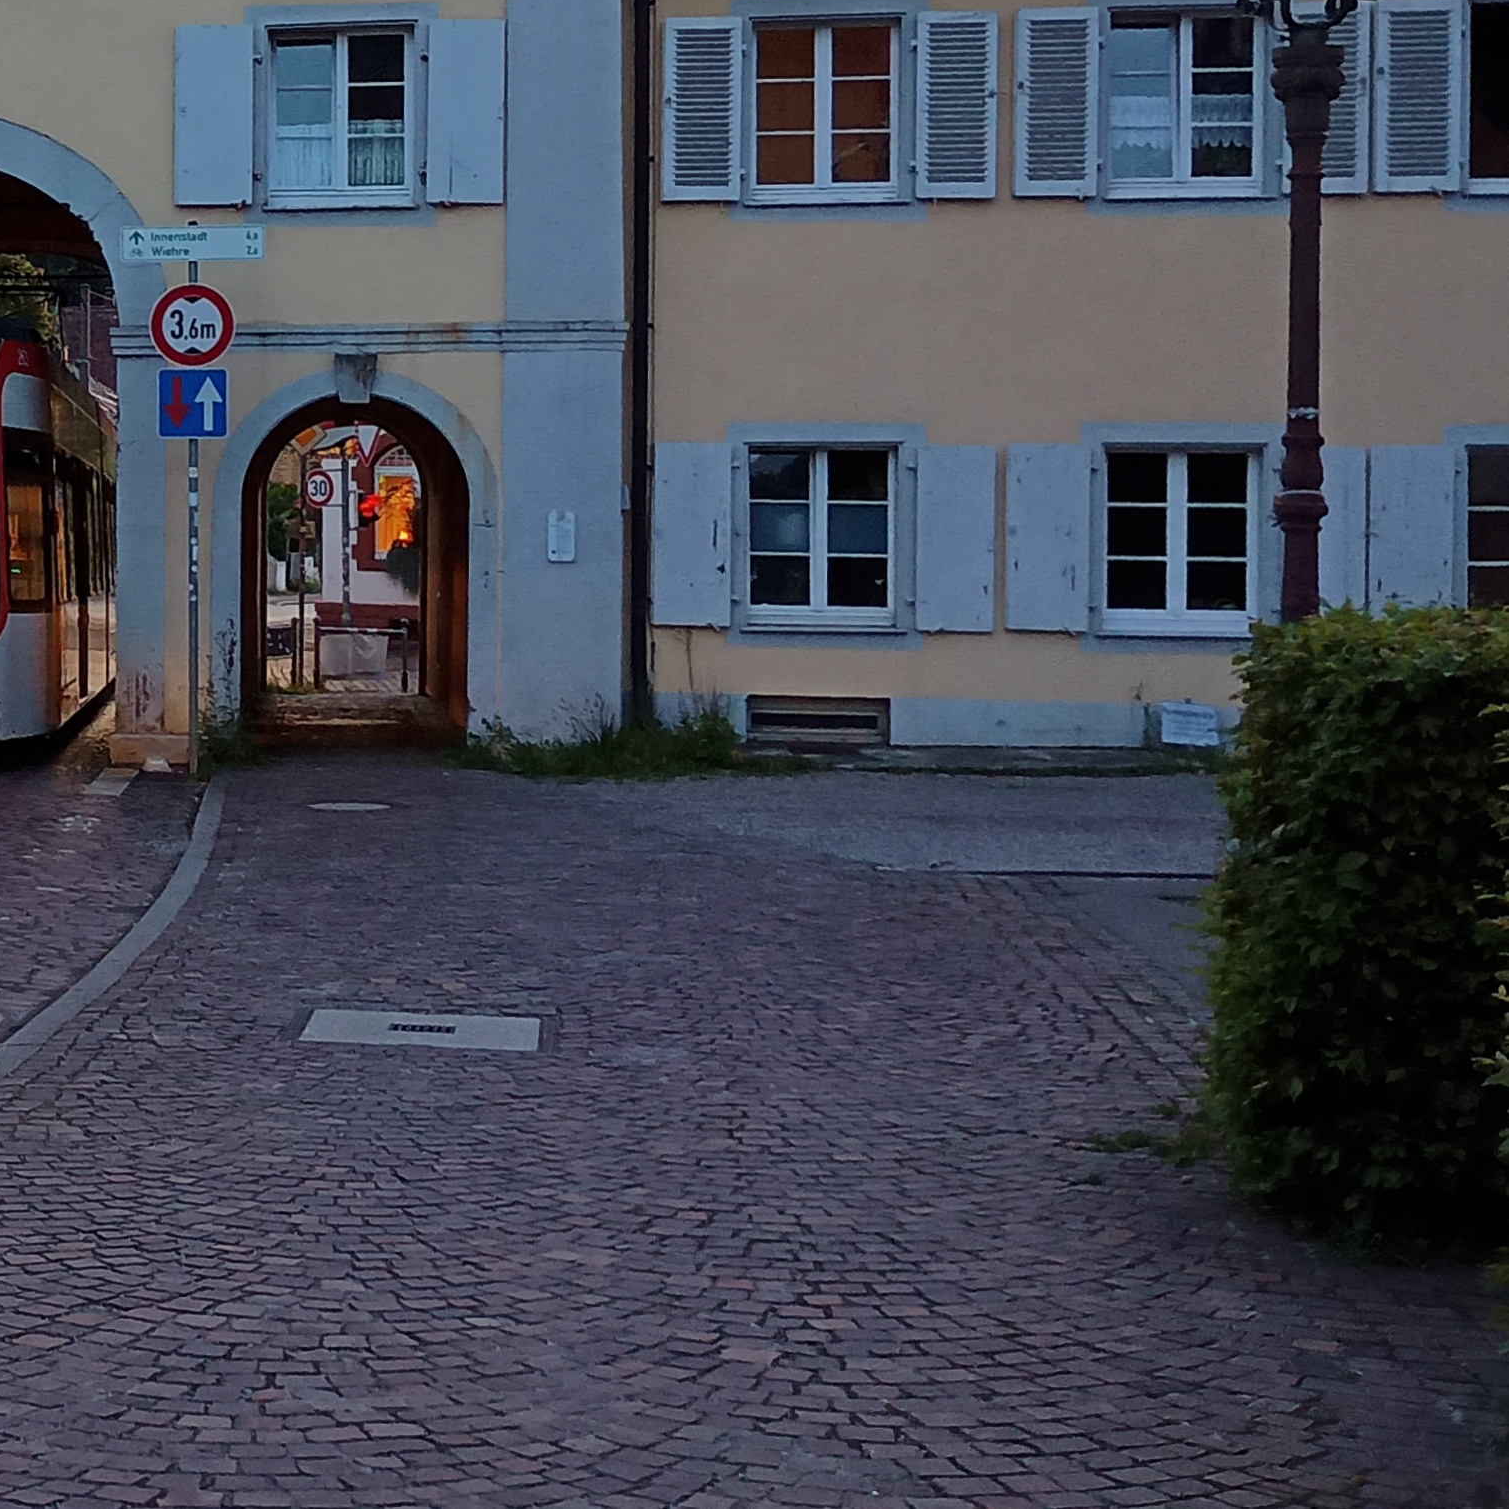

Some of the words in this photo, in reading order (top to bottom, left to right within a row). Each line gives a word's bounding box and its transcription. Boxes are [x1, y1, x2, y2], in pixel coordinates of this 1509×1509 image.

[150, 232, 208, 242] Innenstadt
[151, 246, 191, 257] Wiehre
[311, 479, 328, 497] 30
